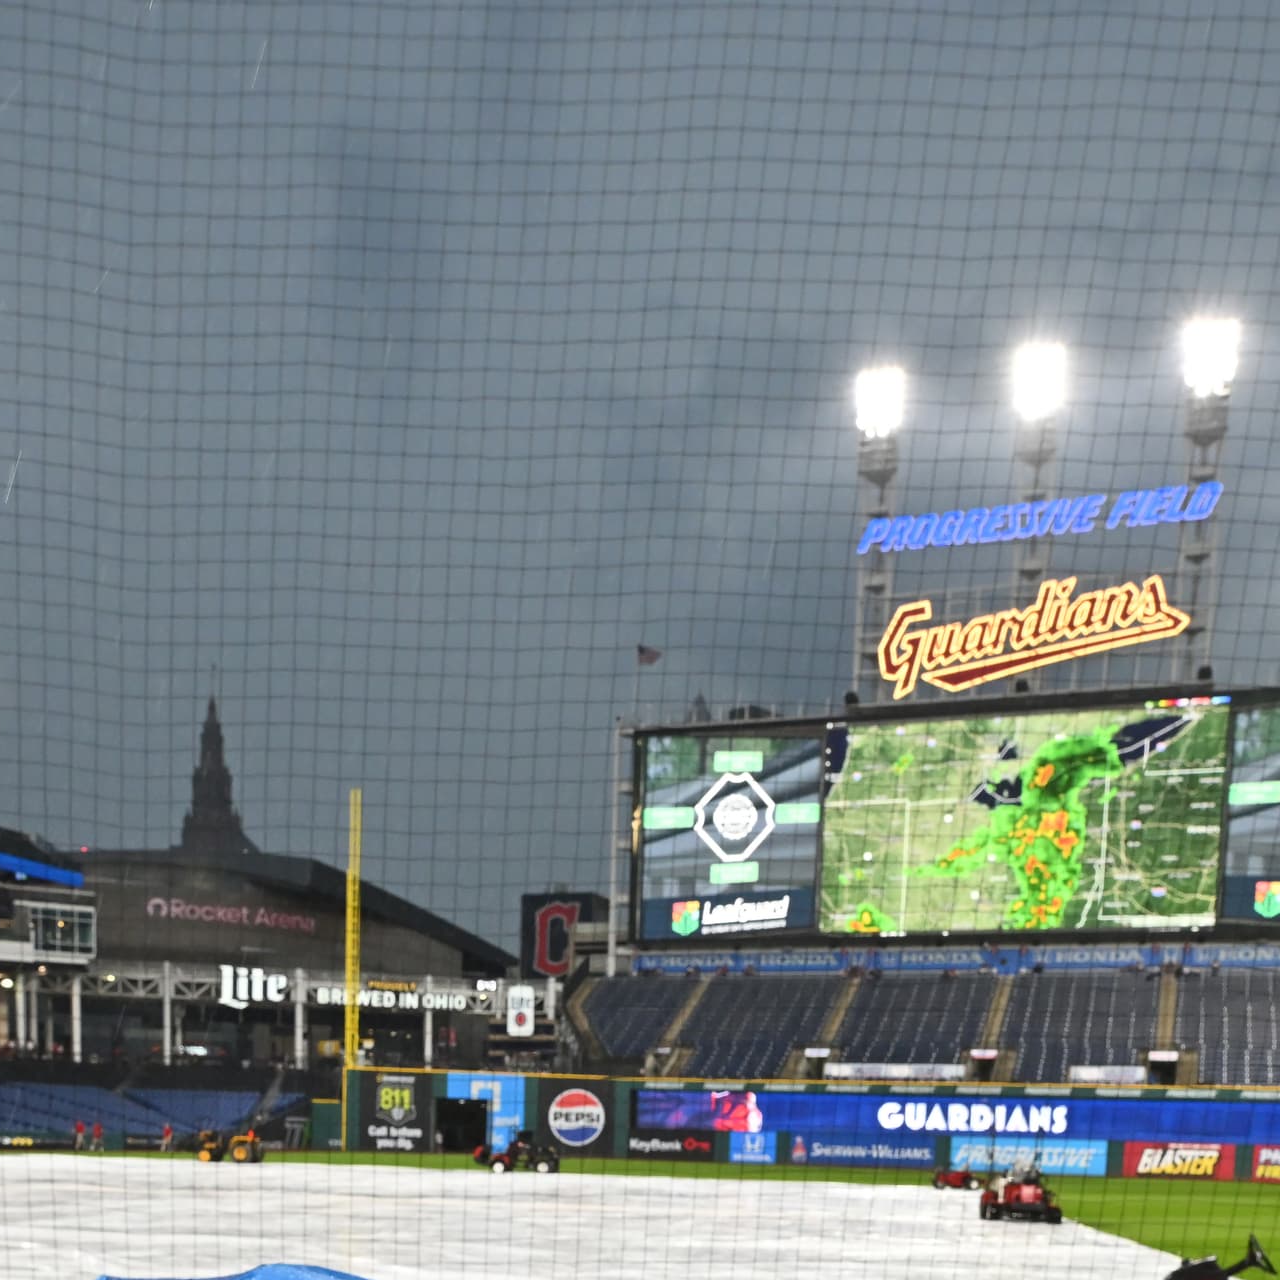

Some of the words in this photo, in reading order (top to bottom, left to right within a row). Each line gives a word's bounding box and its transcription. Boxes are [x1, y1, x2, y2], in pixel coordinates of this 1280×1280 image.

[857, 495, 1107, 554] PROGRESSIVE
[1104, 481, 1224, 529] FIELD
[877, 574, 1191, 699] Guardians
[169, 898, 250, 925] Rocket
[254, 906, 316, 935] Arena
[218, 963, 288, 1009] Lite
[399, 991, 419, 1009] IN
[422, 992, 466, 1010] OHIO
[380, 1087, 412, 1110] 811
[553, 1111, 600, 1123] PEPSI
[877, 1101, 1068, 1134] GUARDIANS
[629, 1137, 682, 1152] KeyBank
[1136, 1148, 1220, 1175] BLASTER
